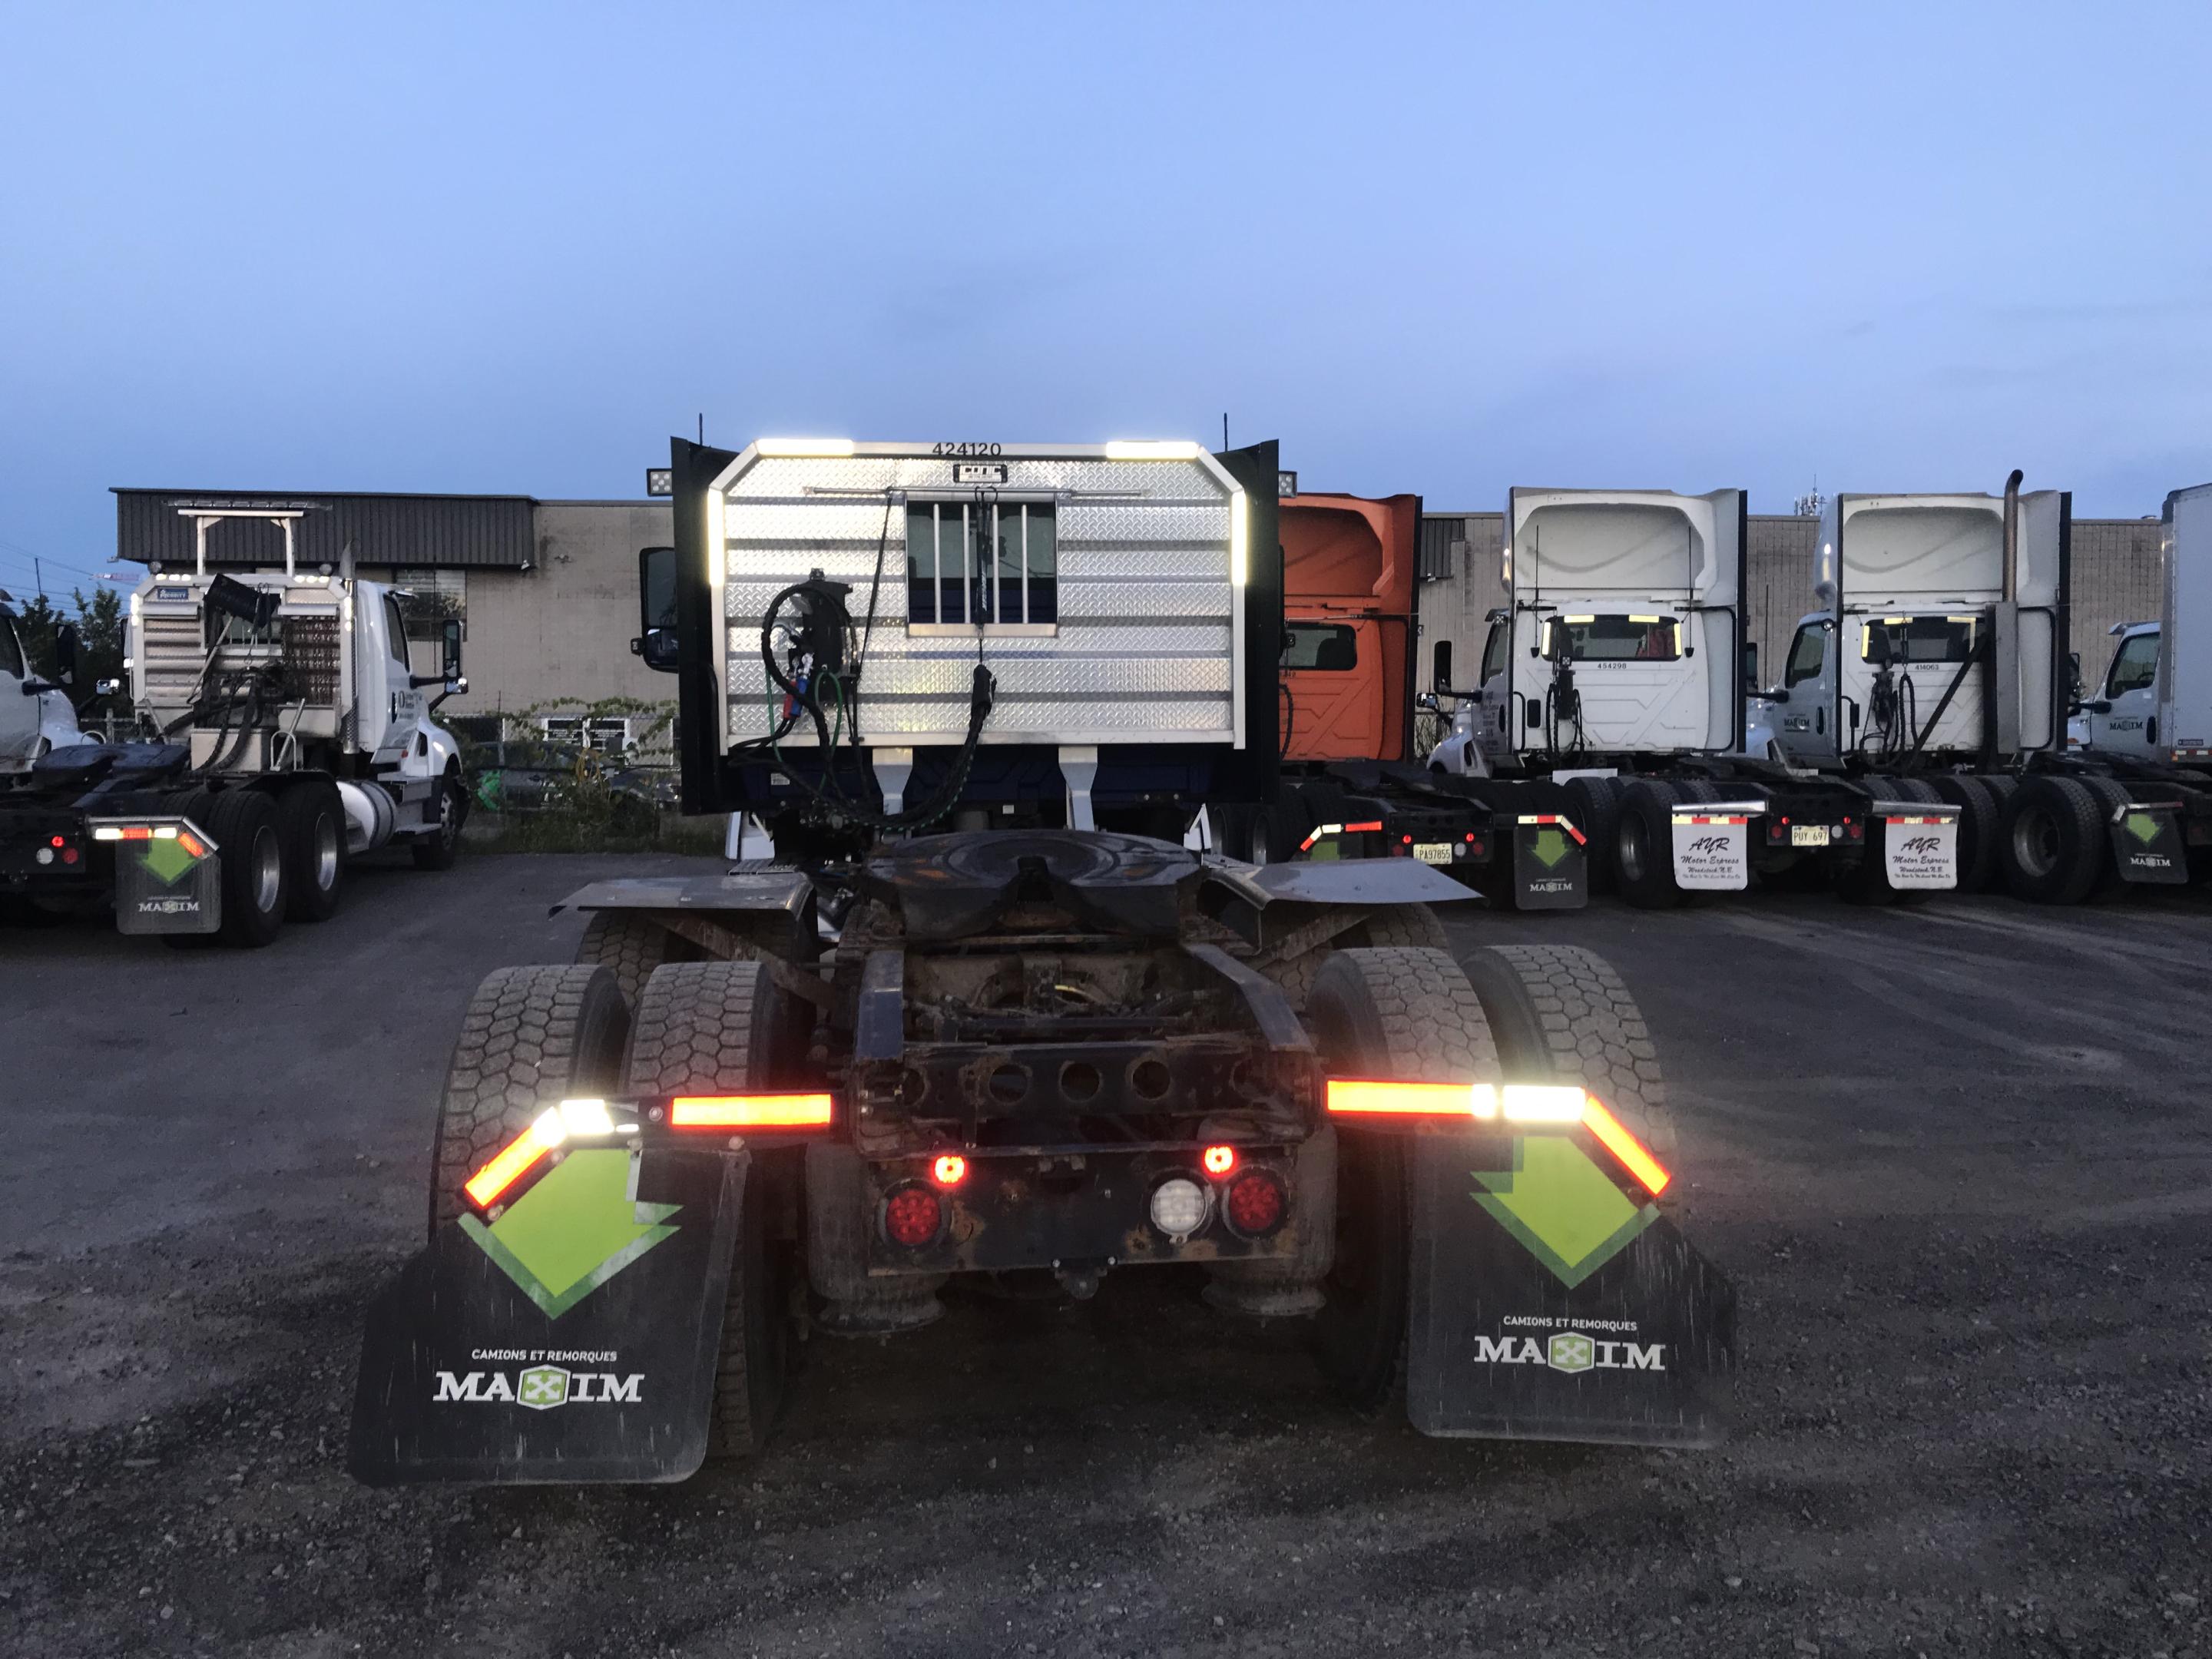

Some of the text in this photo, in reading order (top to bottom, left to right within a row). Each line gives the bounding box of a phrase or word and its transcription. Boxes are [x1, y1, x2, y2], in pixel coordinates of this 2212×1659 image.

[932, 442, 1002, 455] 424120
[1783, 718, 1810, 727] MAIM
[1794, 832, 1827, 841] PUY 697
[1689, 836, 1730, 855] AYR
[1900, 836, 1940, 855] AYR
[1419, 849, 1451, 859] PA97855
[1681, 855, 1739, 866] Motor Express
[1892, 855, 1949, 865] Motor Express
[1503, 1316, 1637, 1332] CAMIONS ET REMORQUES
[472, 1349, 618, 1363] CAMIONS ET REMORQUES
[1474, 1332, 1666, 1373] MAXIM
[432, 1364, 645, 1410] MAXIM
